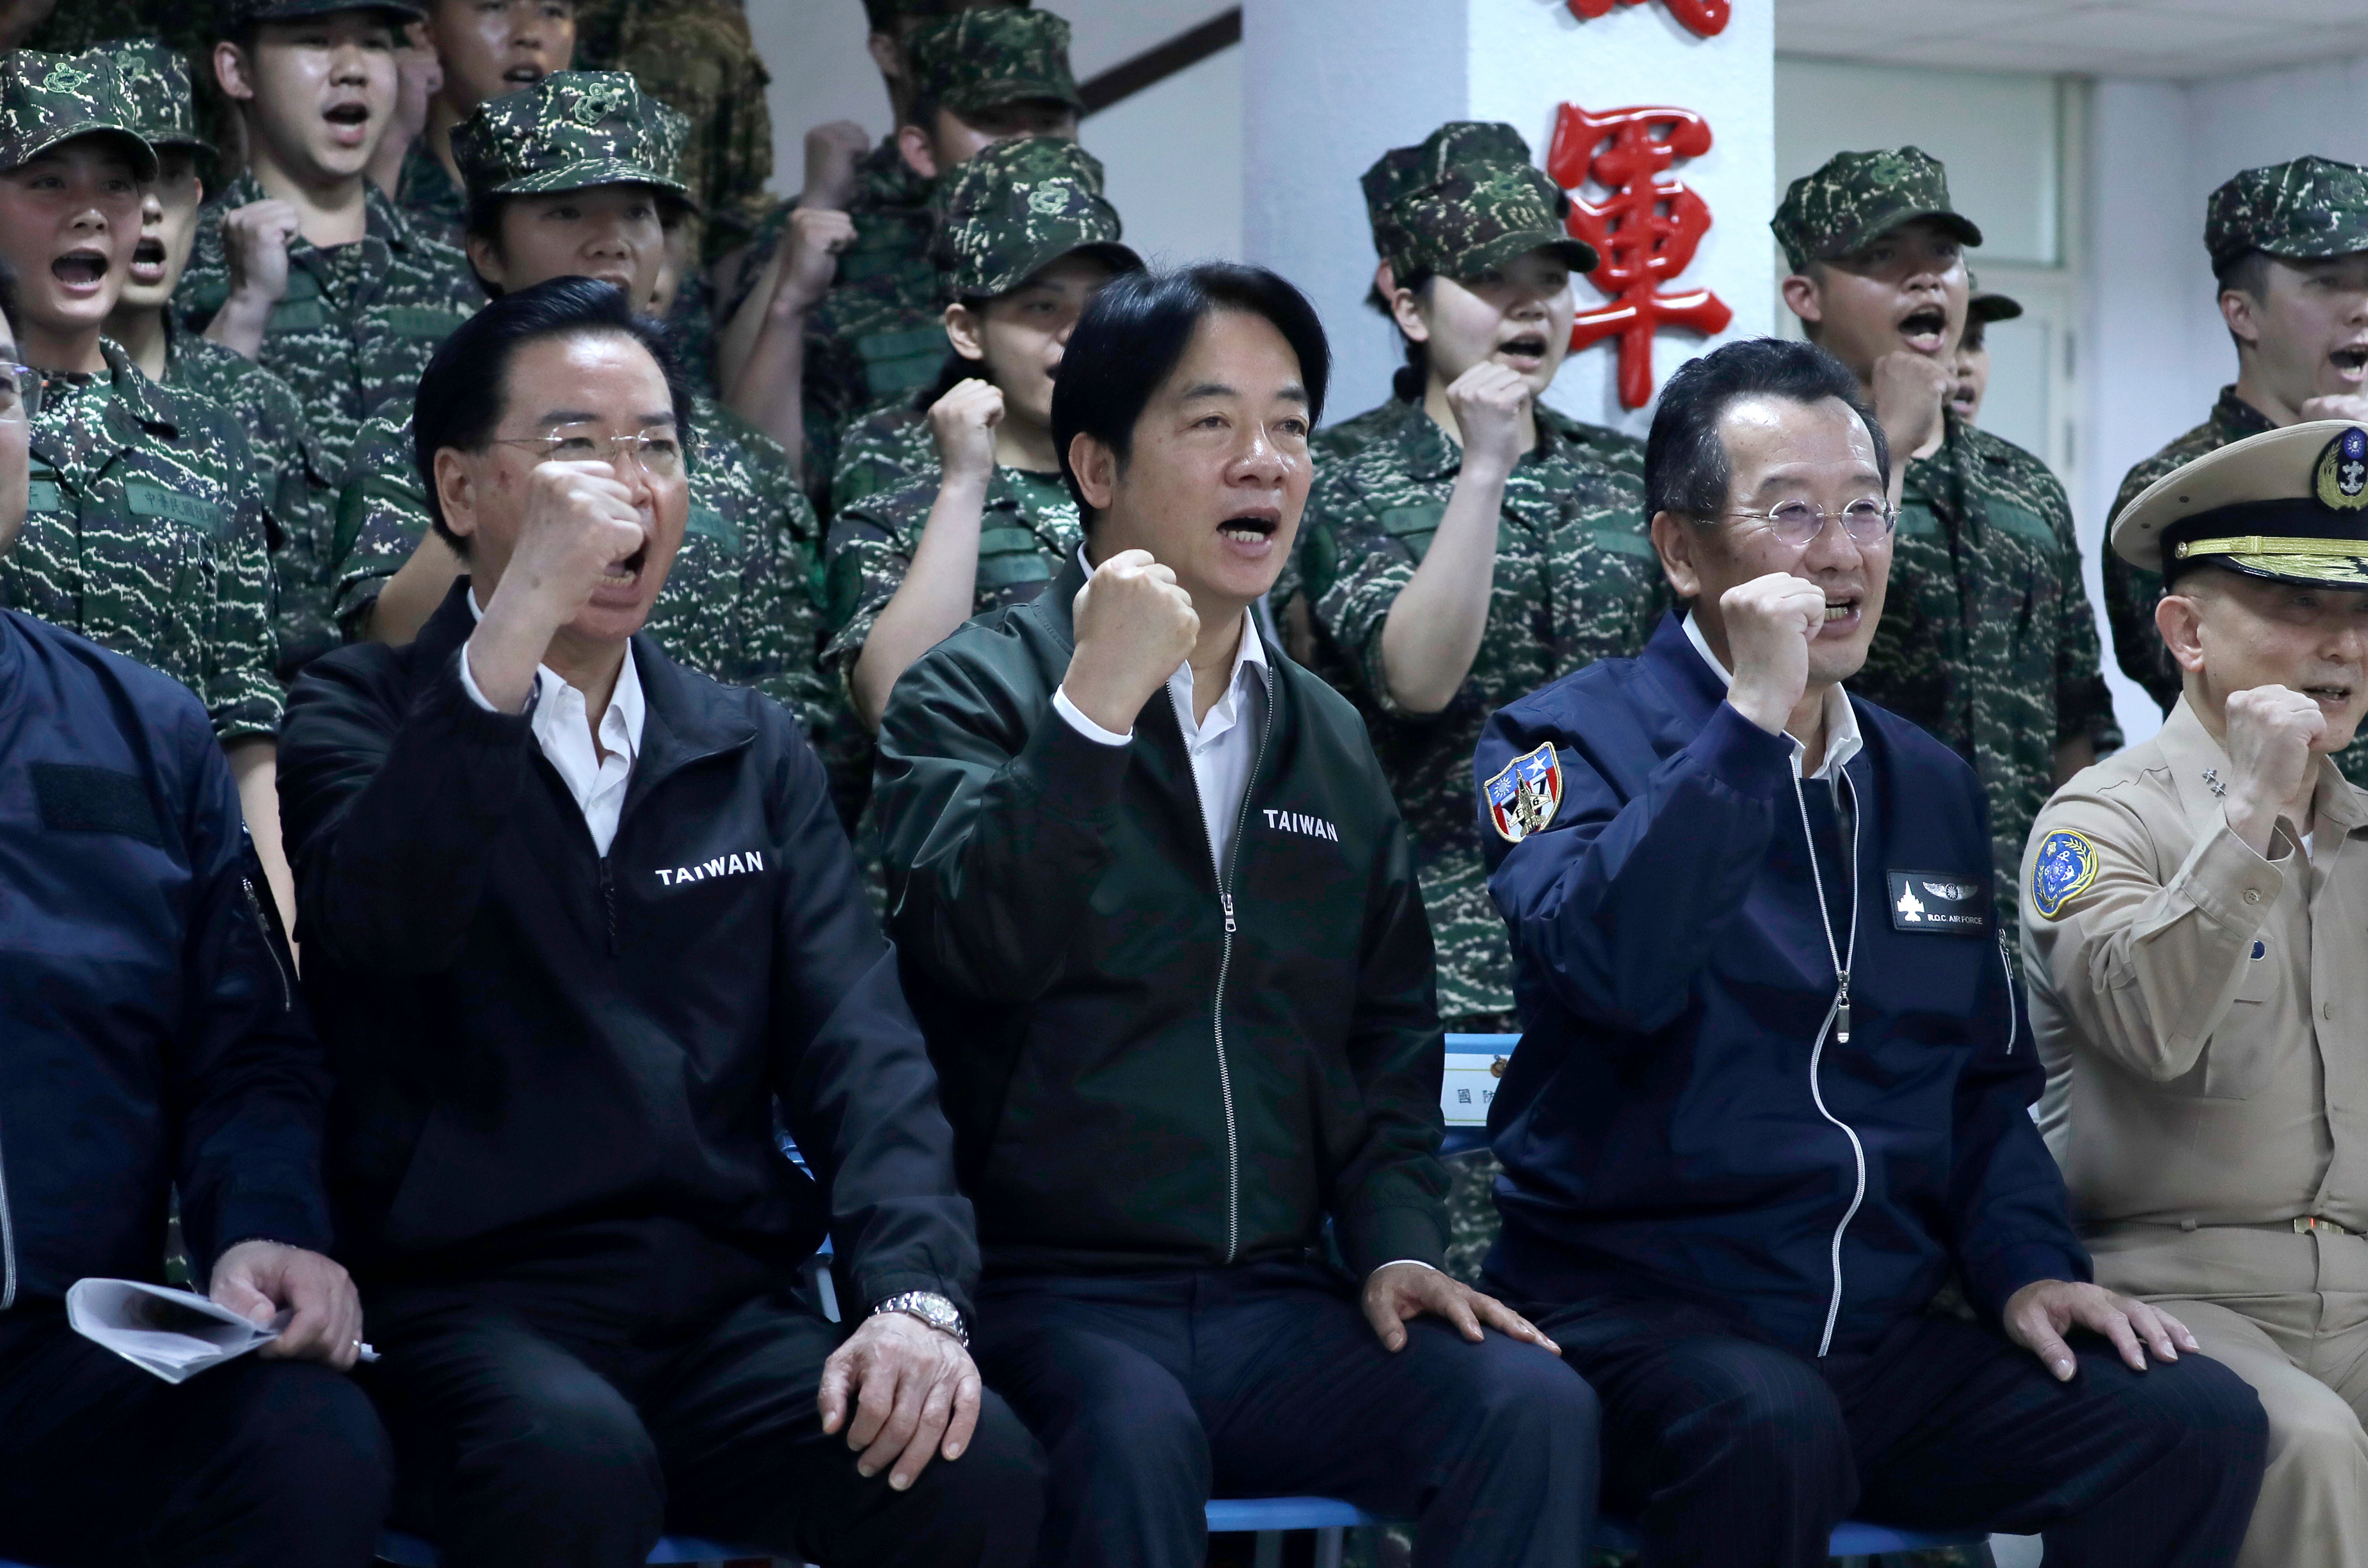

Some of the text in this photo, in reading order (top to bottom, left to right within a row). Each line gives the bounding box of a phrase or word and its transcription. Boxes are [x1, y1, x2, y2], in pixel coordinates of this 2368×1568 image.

[1547, 0, 1733, 410] 軍
[1263, 809, 1338, 842] TAIWAN
[655, 851, 764, 885] TAIWAN
[1961, 916, 1983, 924] FORCE
